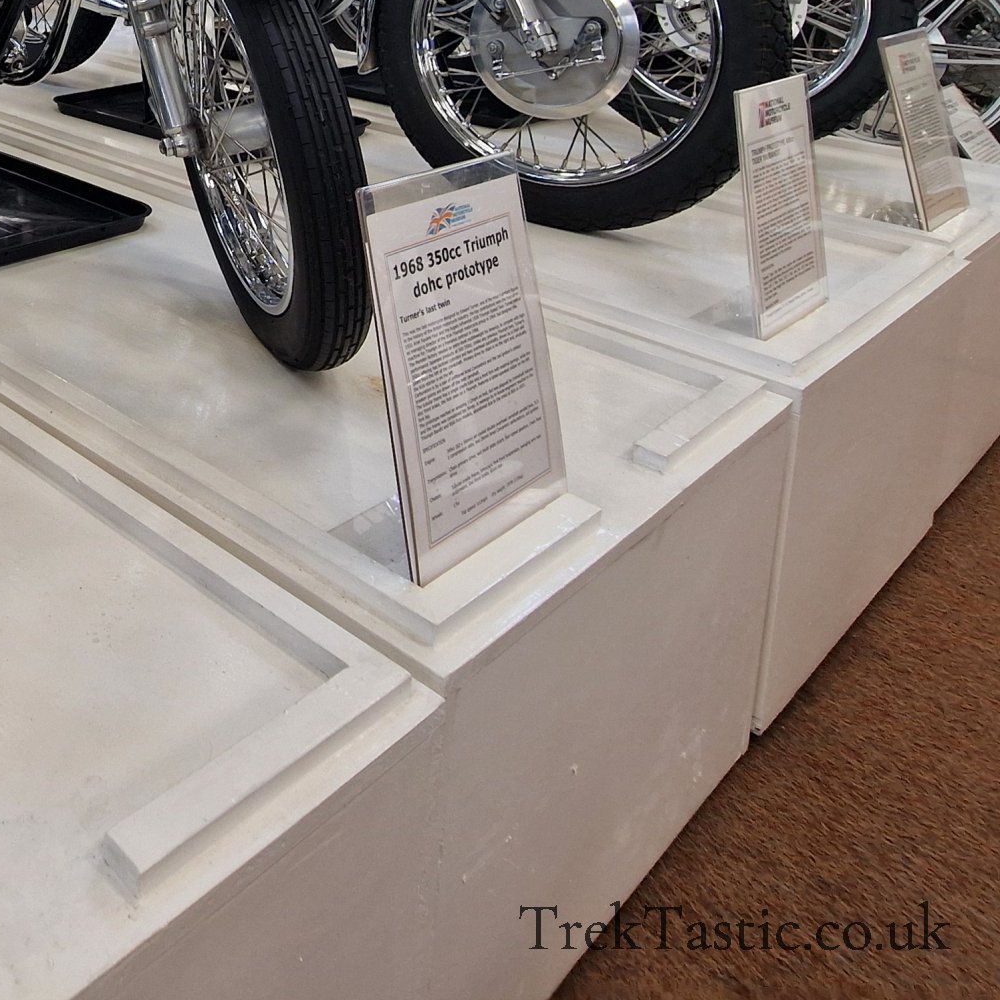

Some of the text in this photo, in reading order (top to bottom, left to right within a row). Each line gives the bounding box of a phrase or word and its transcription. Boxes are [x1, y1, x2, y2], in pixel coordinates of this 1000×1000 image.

[393, 227, 509, 280] 1968 350cc Triumph
[413, 255, 500, 298] dohc prototype
[399, 299, 451, 324] Turner's last twin
